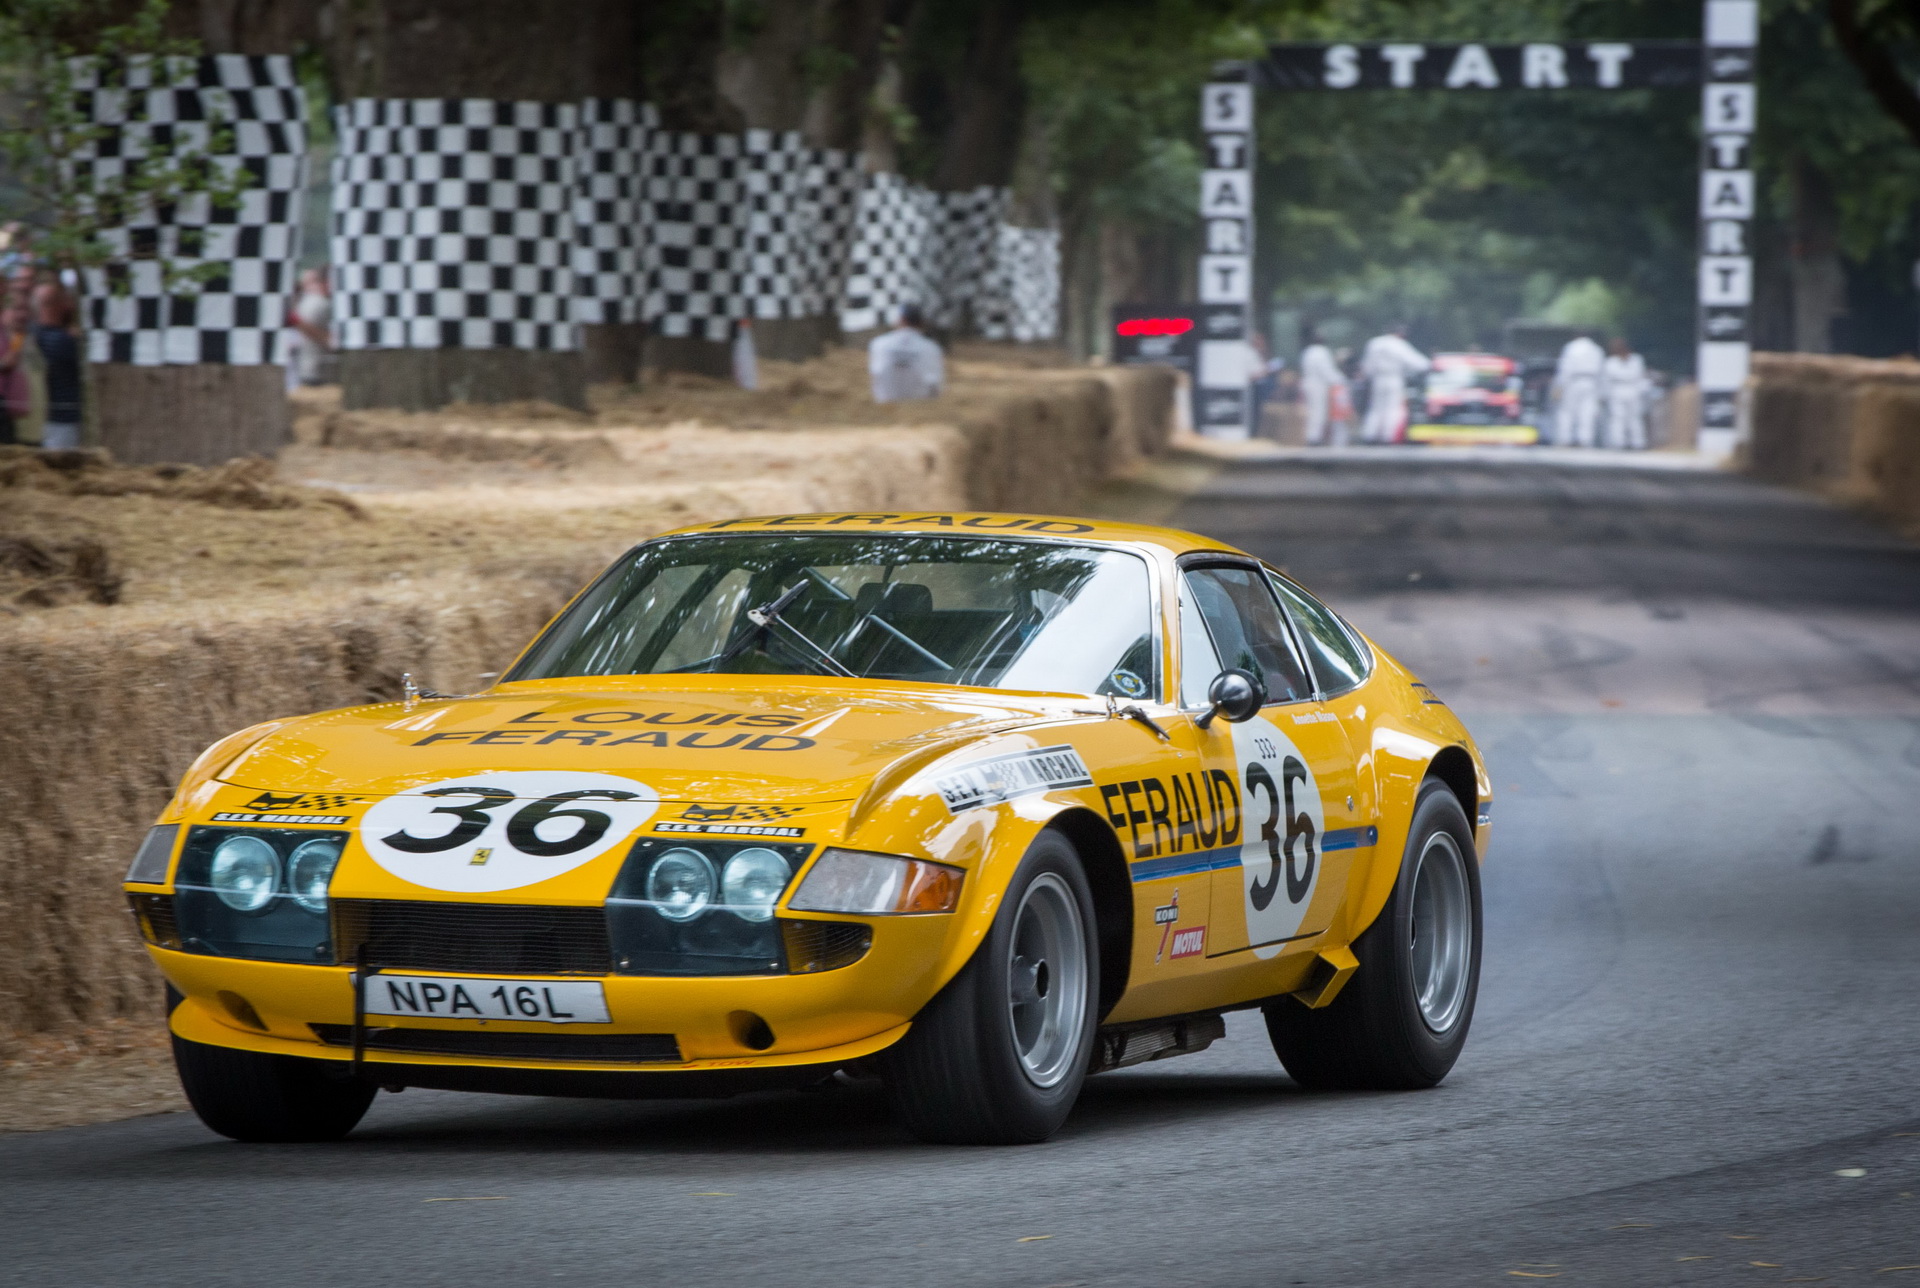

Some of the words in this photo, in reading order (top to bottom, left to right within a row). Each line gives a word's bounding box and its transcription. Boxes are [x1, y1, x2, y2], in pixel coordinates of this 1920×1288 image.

[1323, 42, 1633, 88] START
[1207, 91, 1245, 293] START
[1709, 93, 1749, 294] START
[710, 514, 1094, 534] FERAUD
[508, 711, 804, 727] LOUIS
[410, 729, 817, 751] FERAUD
[257, 814, 346, 824] MARCHAL
[380, 786, 641, 856] 36
[1099, 769, 1240, 859] FERAUD
[705, 825, 801, 837] MARCHAL
[1246, 755, 1316, 911] 36
[1156, 908, 1178, 921] KONI
[1171, 930, 1203, 955] MOTUL
[386, 980, 483, 1015] NPA
[491, 985, 575, 1019] 16L
